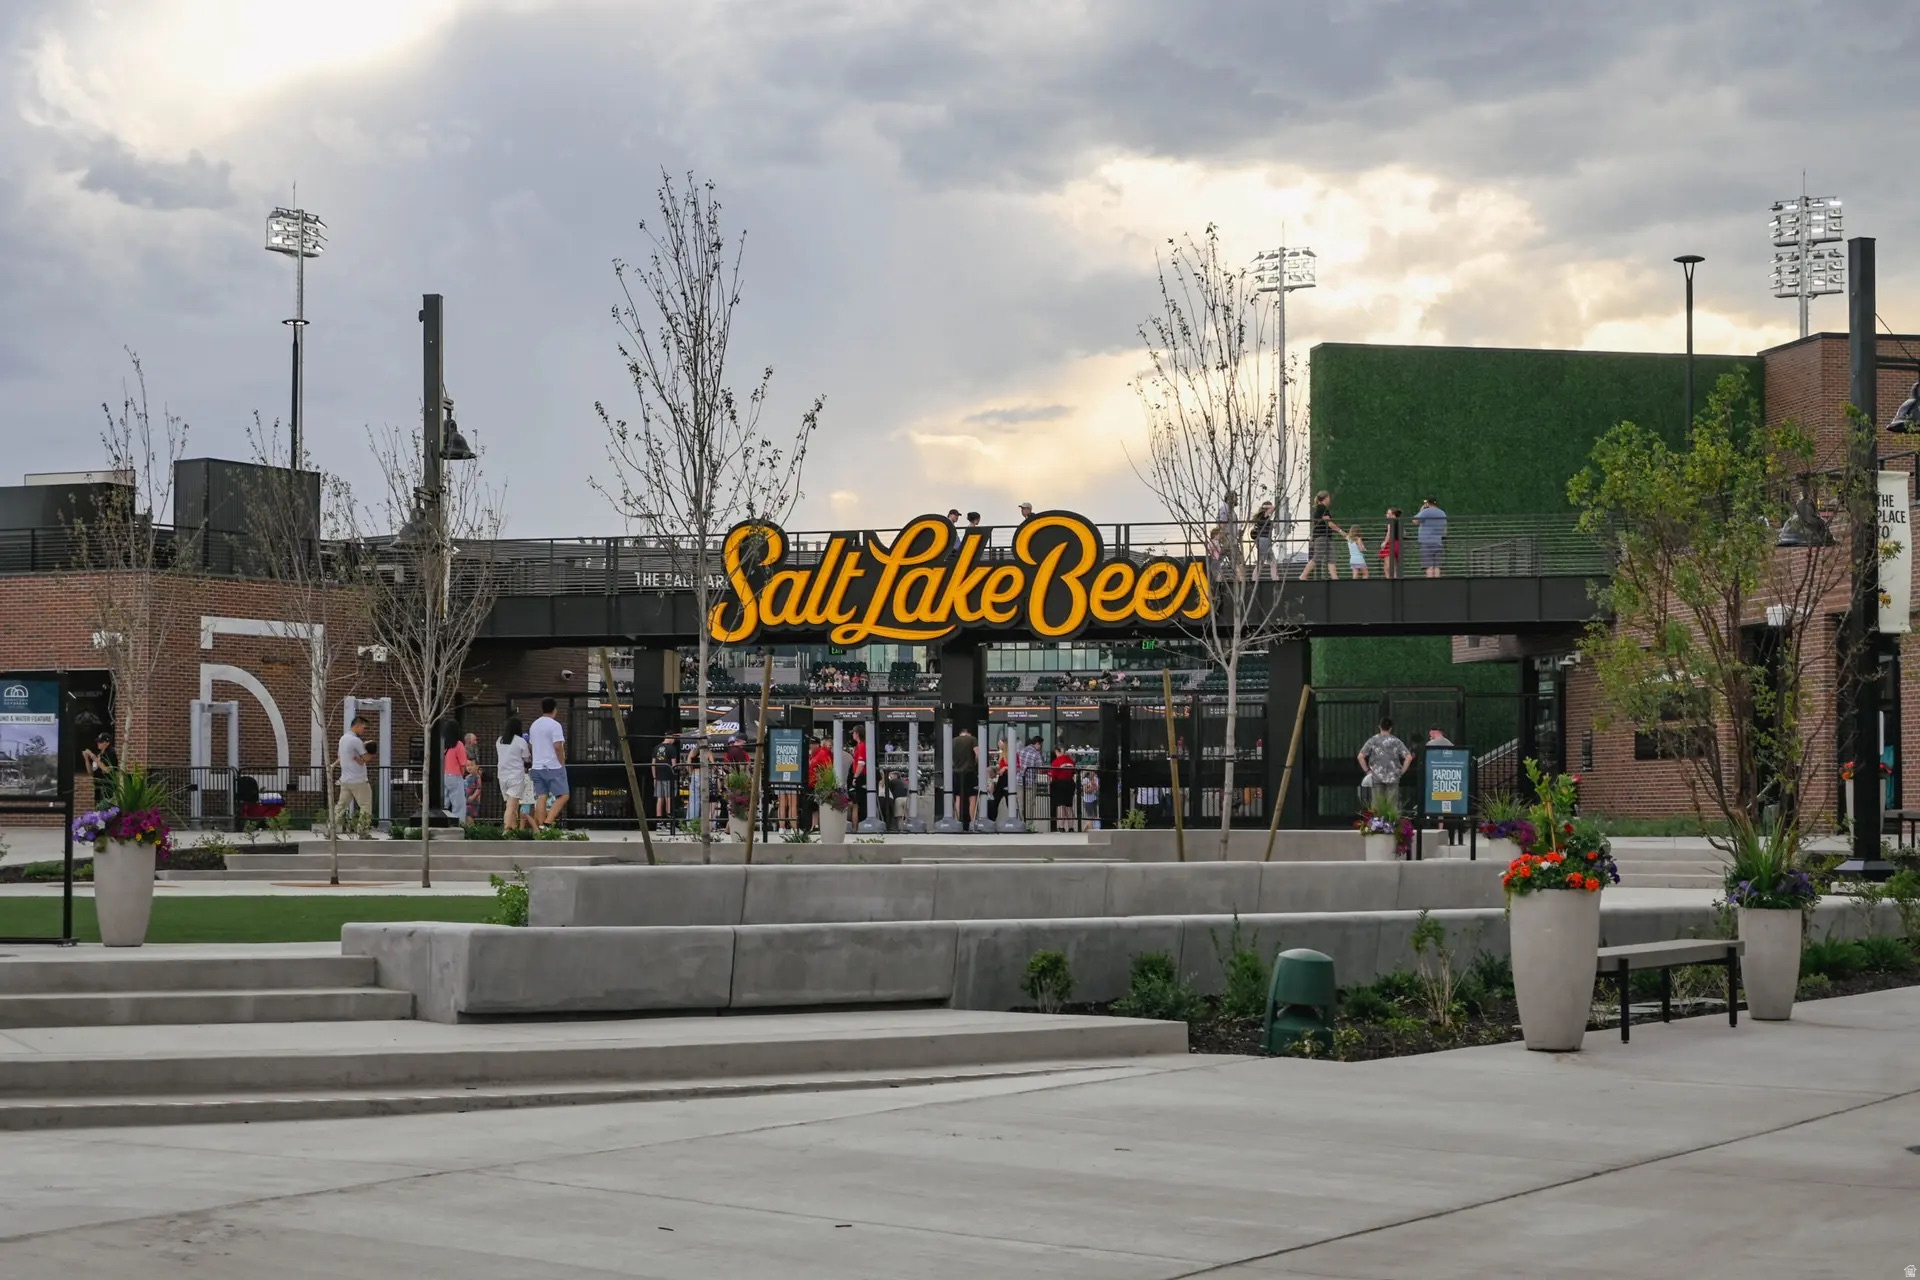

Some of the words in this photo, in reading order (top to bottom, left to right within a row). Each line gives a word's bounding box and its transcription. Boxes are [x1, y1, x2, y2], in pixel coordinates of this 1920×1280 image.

[1877, 510, 1907, 523] PLACE
[634, 572, 660, 587] THE
[708, 523, 865, 643] Salt
[831, 519, 1025, 645] Lake
[1015, 516, 1212, 636] Bees
[776, 745, 799, 755] PARDON
[782, 755, 798, 764] DUST
[1432, 769, 1462, 780] PARDON
[1440, 780, 1461, 792] DUST
